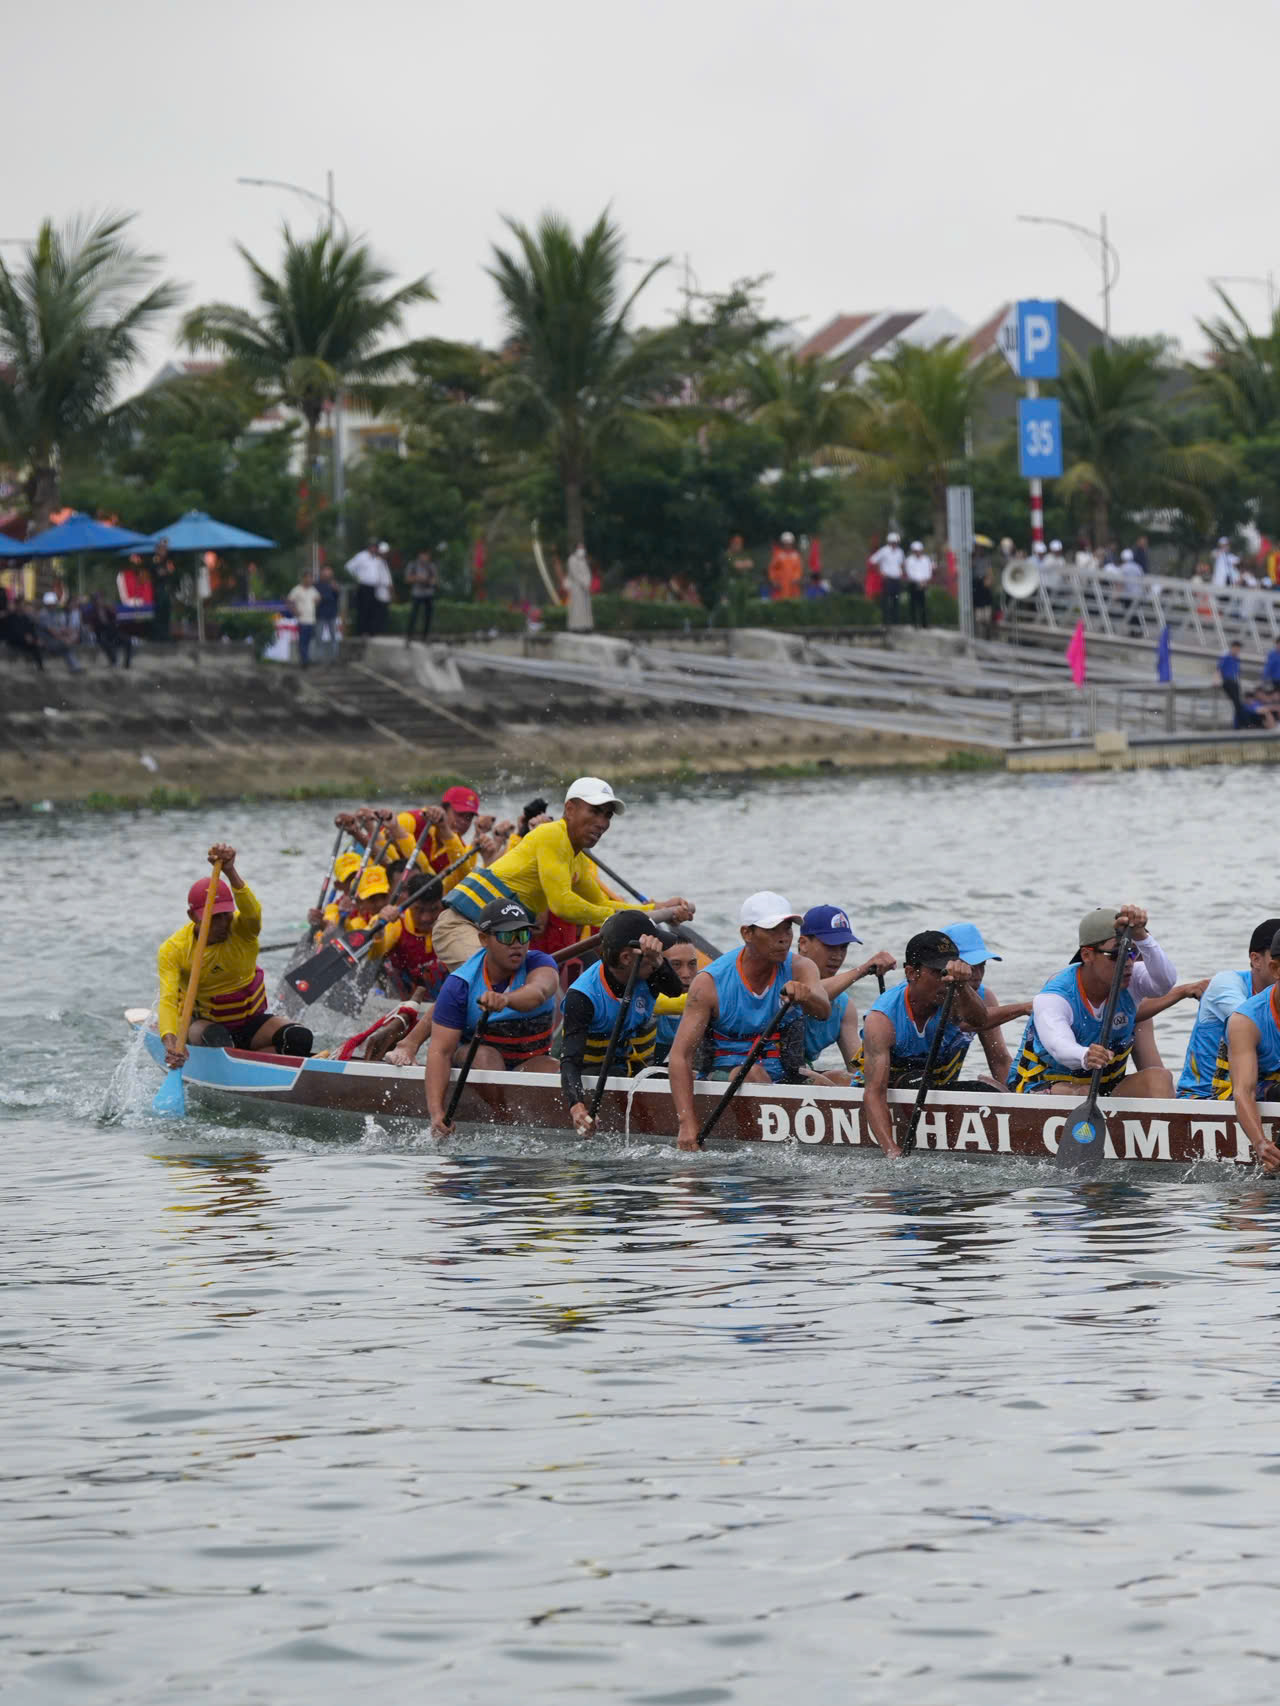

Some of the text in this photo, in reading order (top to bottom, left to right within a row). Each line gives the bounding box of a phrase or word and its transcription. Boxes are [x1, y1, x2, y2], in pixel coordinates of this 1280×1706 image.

[1025, 315, 1050, 362] P
[1026, 420, 1053, 456] 35
[915, 1106, 1014, 1153] HẢI
